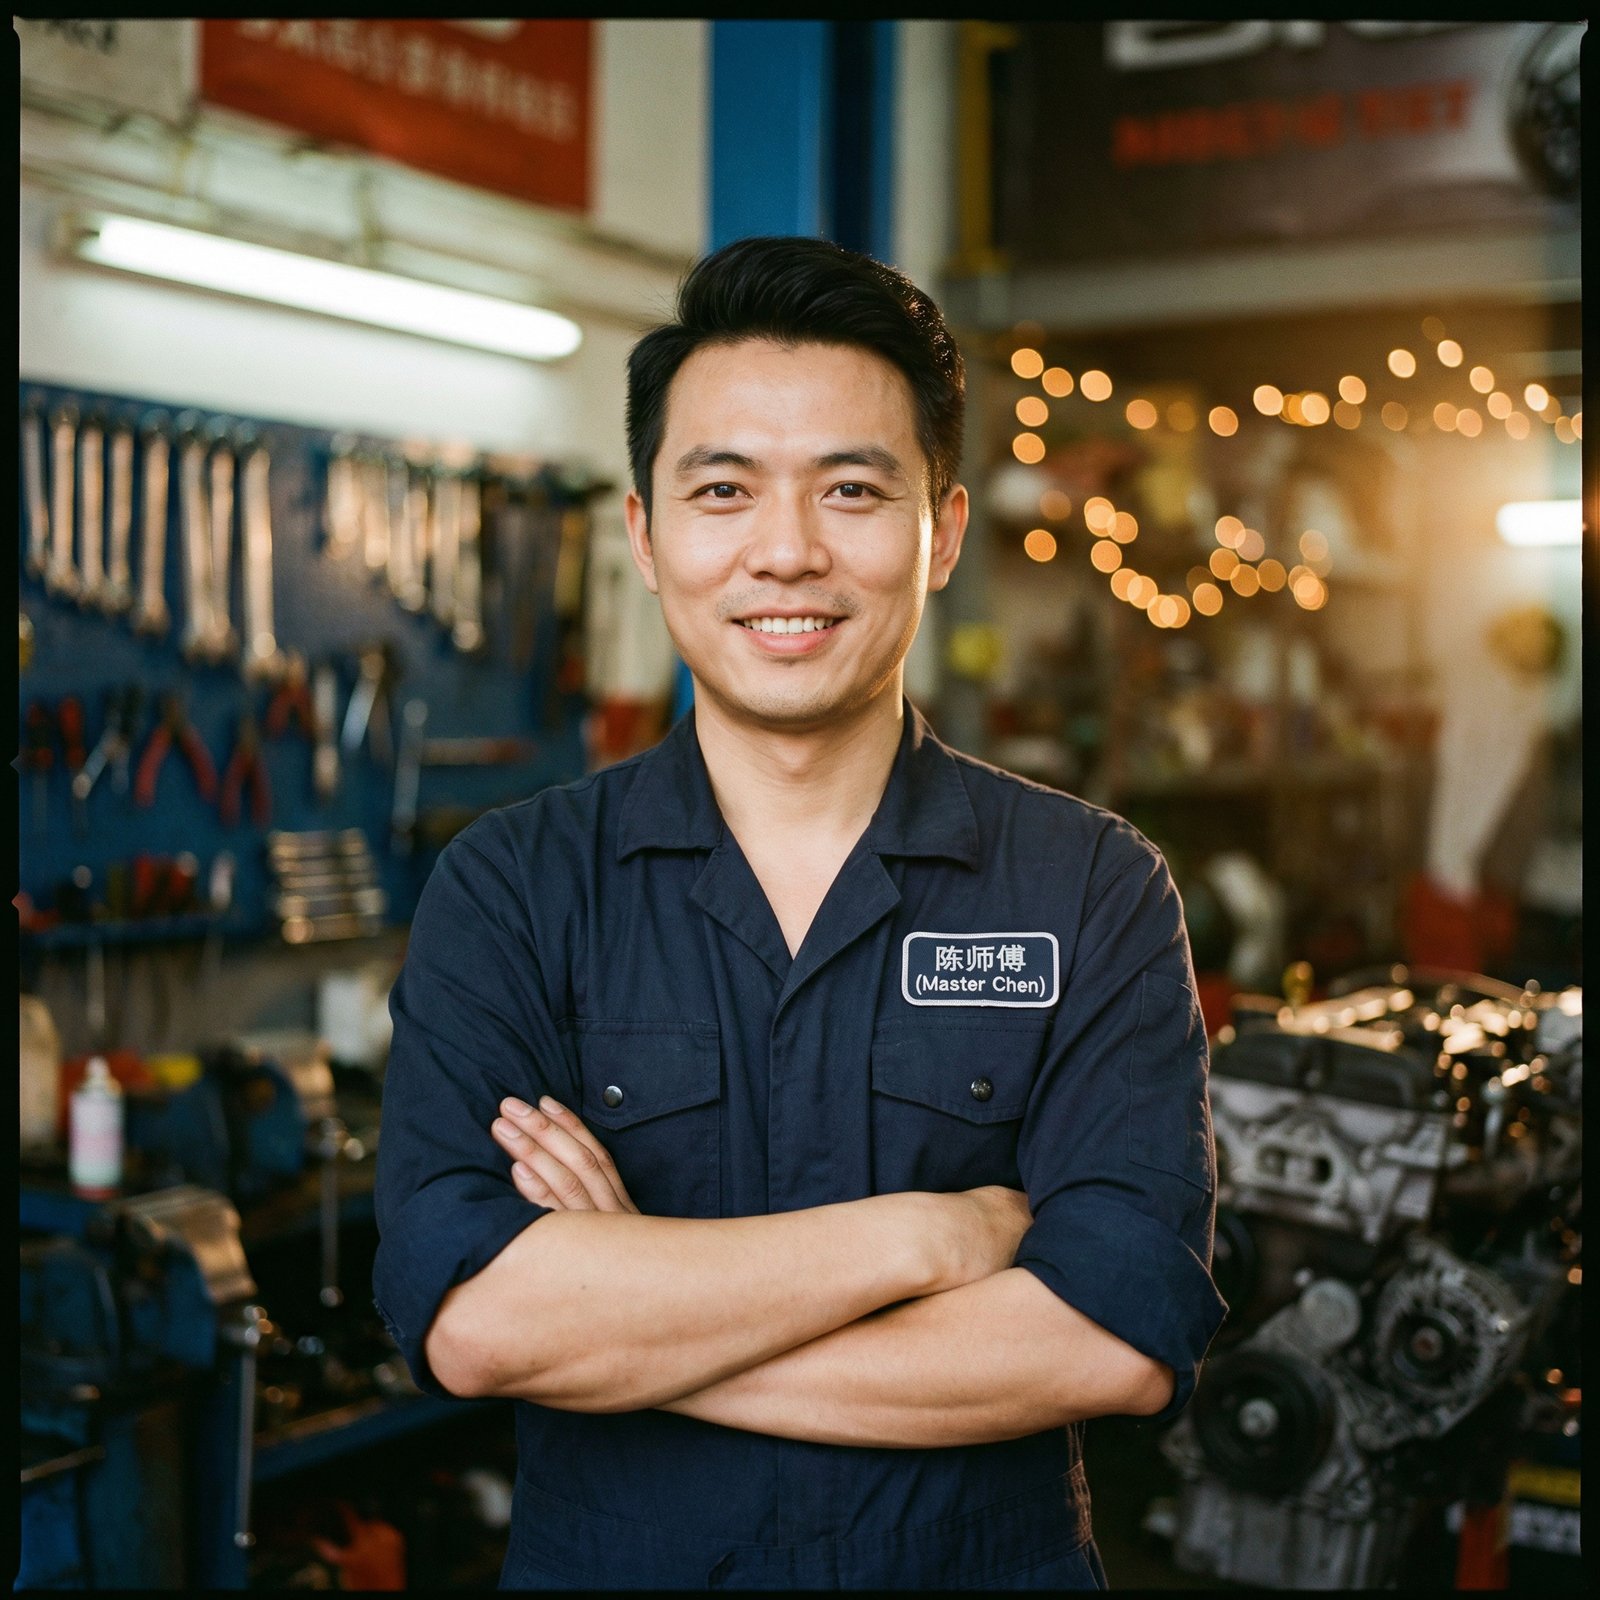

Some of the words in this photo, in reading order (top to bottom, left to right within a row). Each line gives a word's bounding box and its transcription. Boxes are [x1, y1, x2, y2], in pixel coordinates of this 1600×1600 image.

[935, 944, 1026, 972] 陈师傅
[916, 974, 985, 995] (Master
[992, 976, 1046, 998] Chen)
